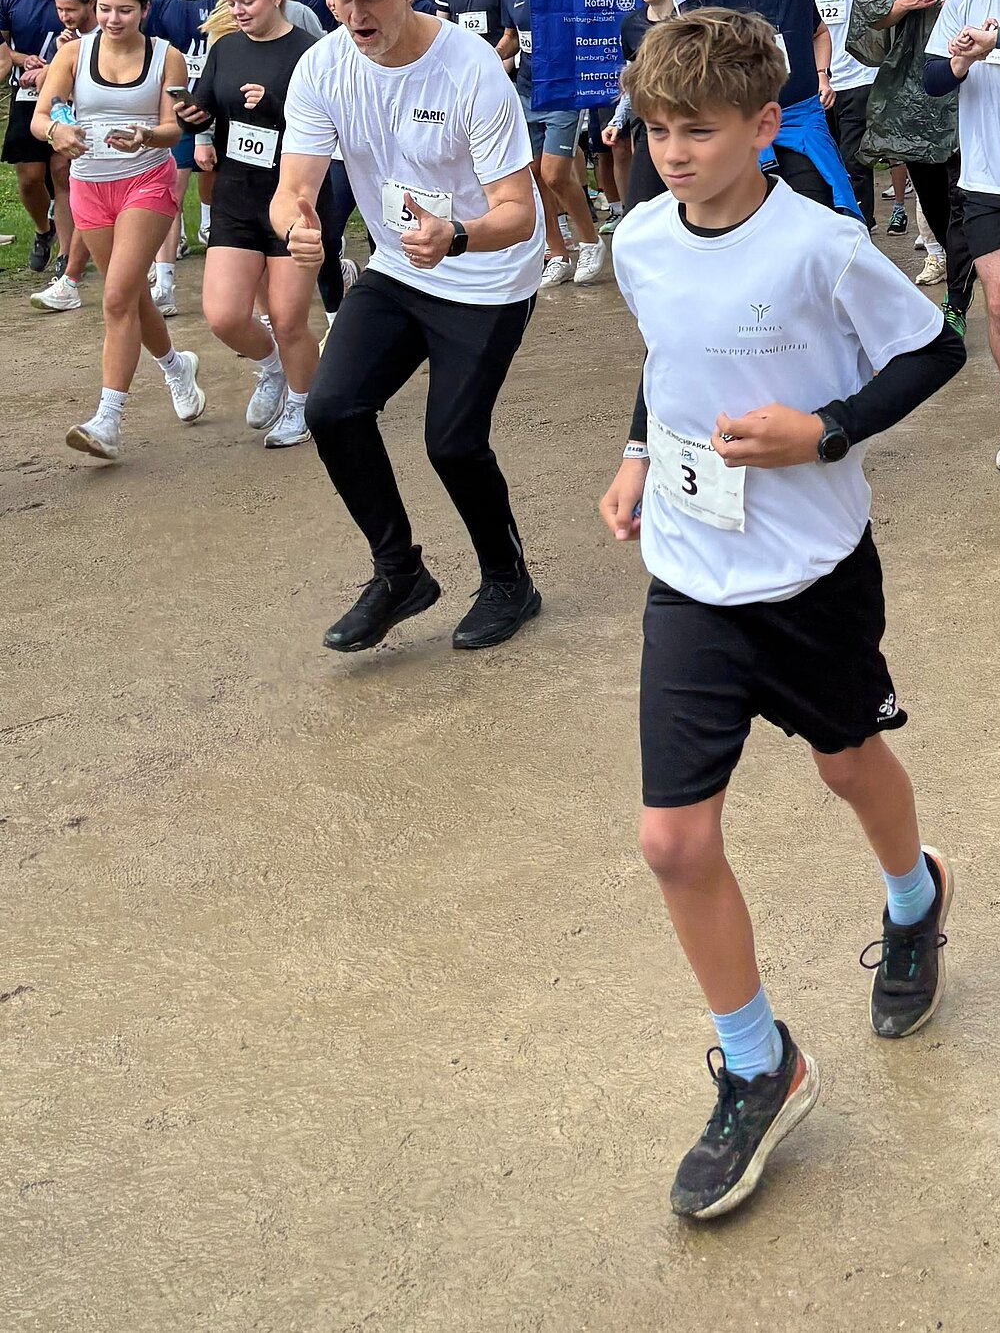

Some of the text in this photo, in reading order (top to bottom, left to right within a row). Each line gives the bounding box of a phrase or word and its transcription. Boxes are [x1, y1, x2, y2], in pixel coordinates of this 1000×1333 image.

[820, 8, 839, 17] 122
[464, 20, 480, 29] 162
[576, 36, 617, 46] Rotaract
[581, 71, 619, 81] Interact
[238, 137, 264, 154] 190
[681, 464, 698, 496] 3
